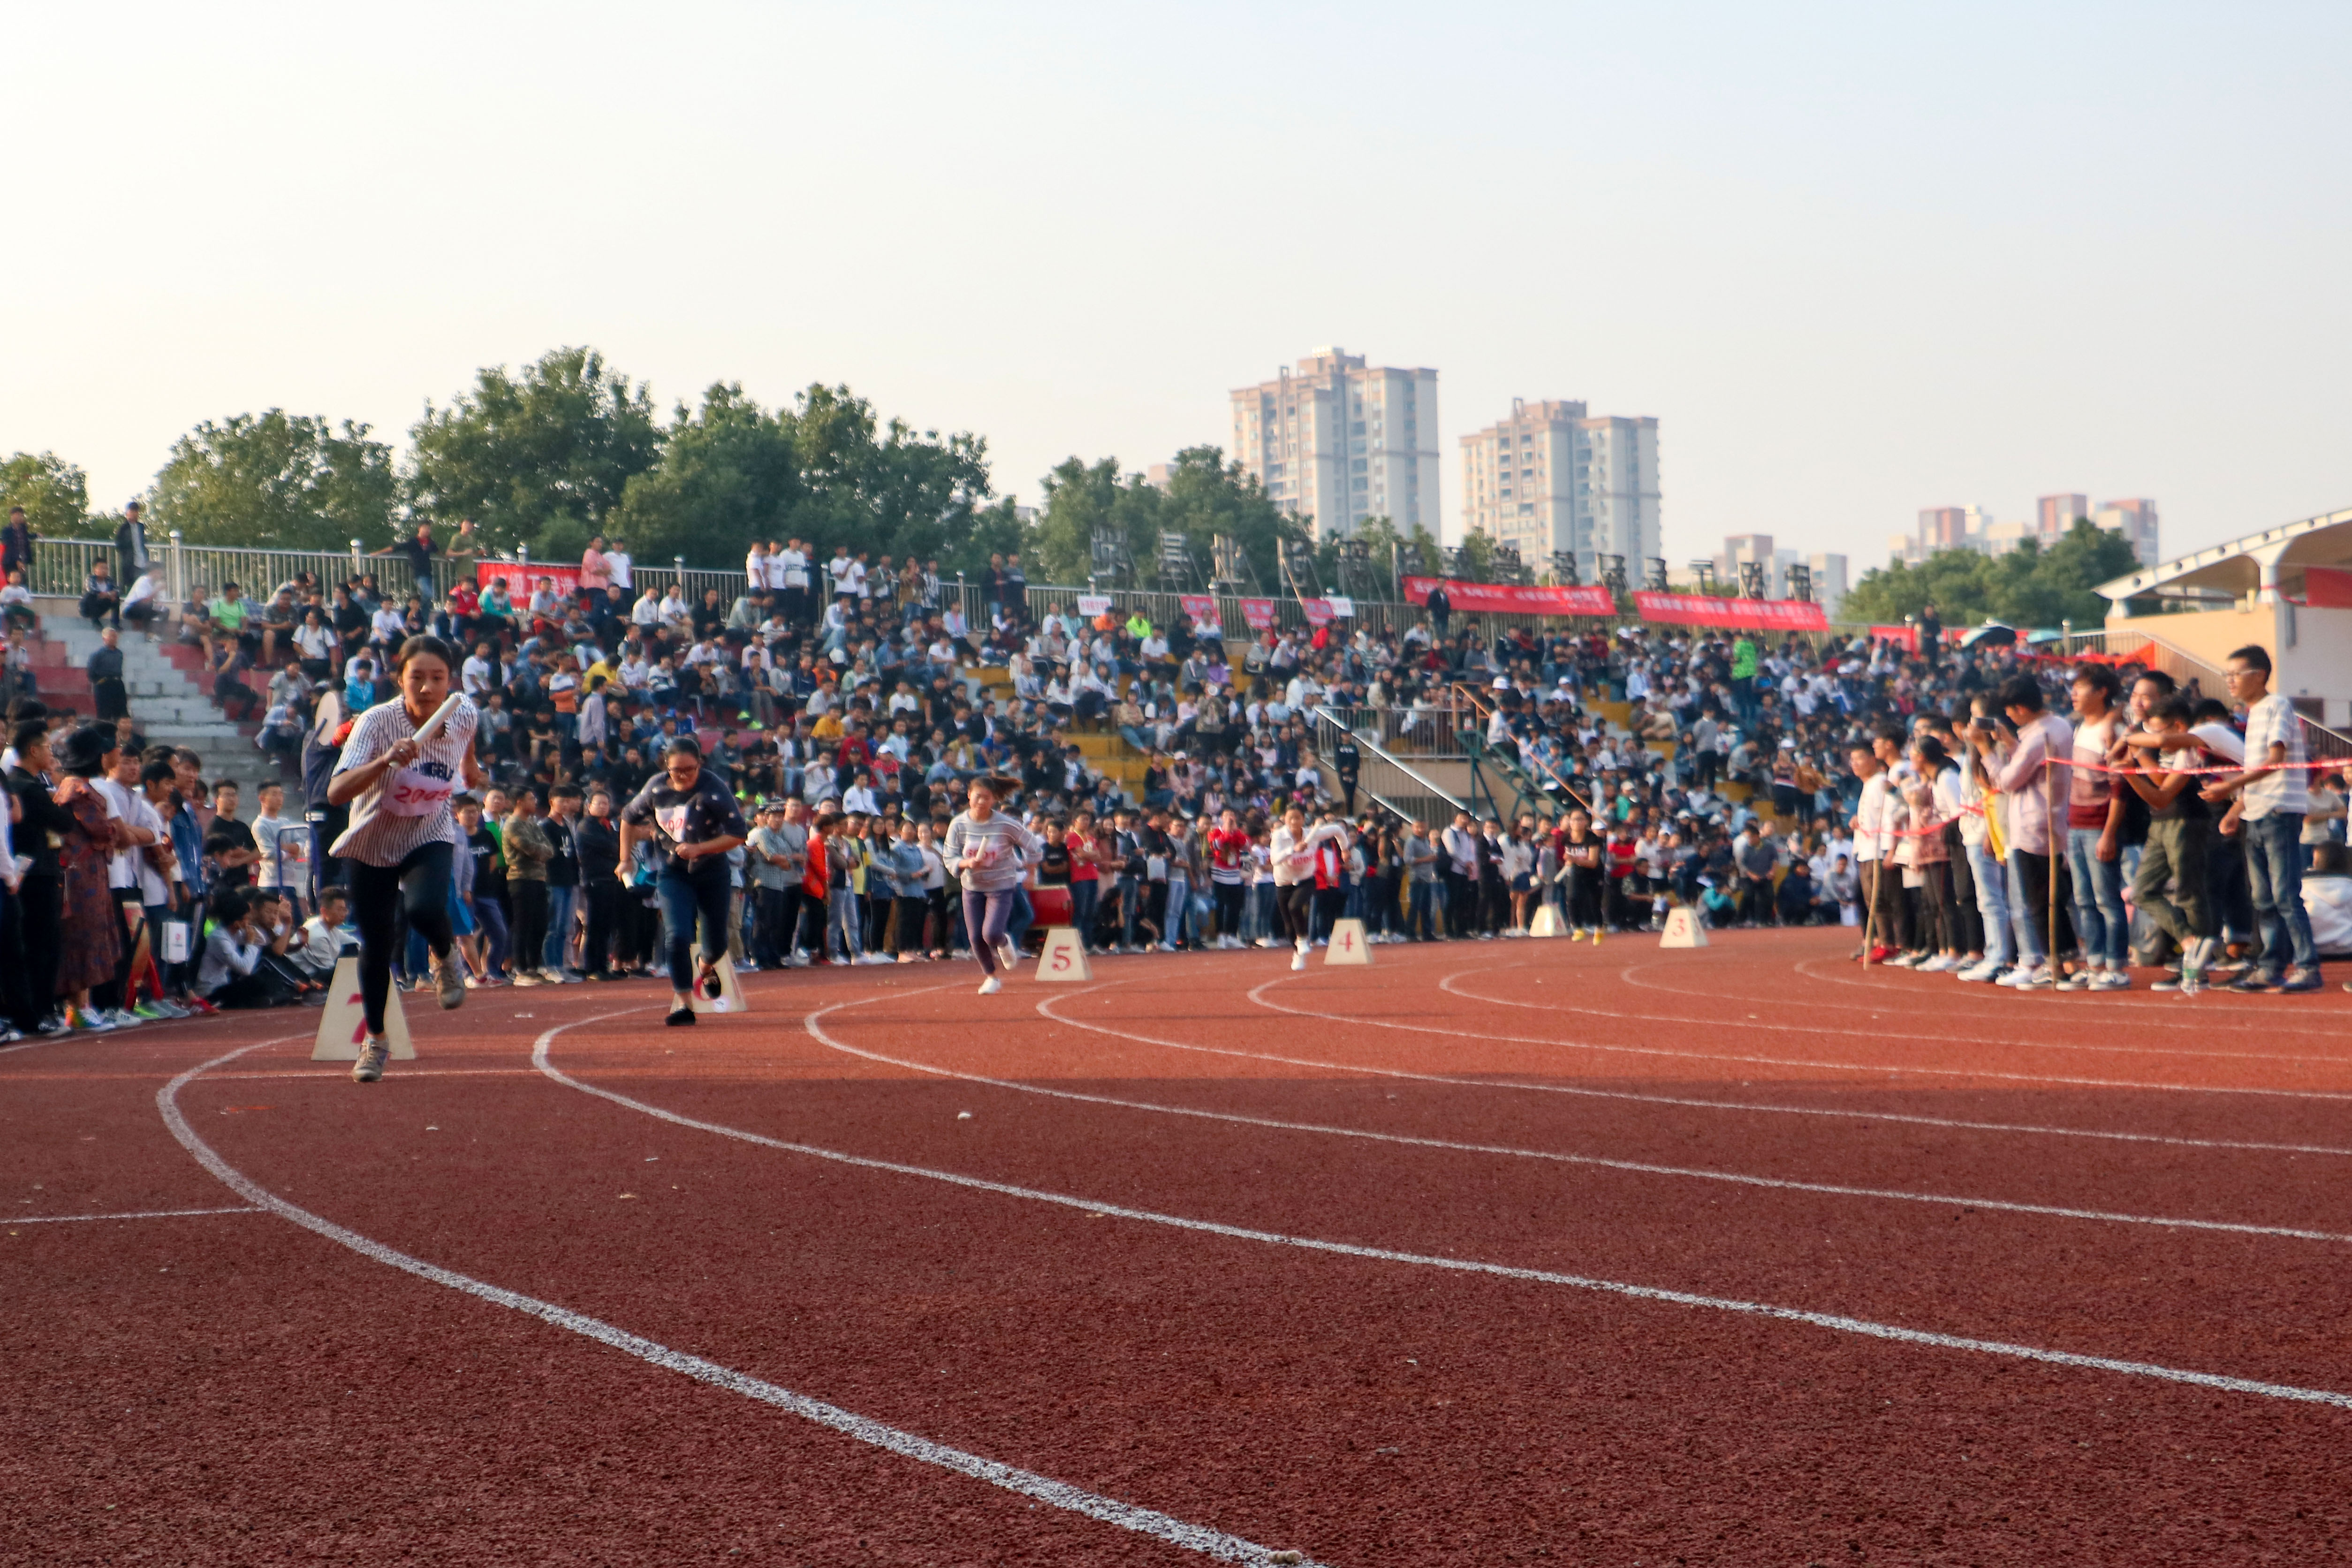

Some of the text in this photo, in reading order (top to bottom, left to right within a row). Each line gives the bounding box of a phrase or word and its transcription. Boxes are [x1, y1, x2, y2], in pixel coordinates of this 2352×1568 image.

[1672, 918, 1685, 937] 3
[1338, 931, 1353, 952] 4
[1052, 946, 1071, 971] 5
